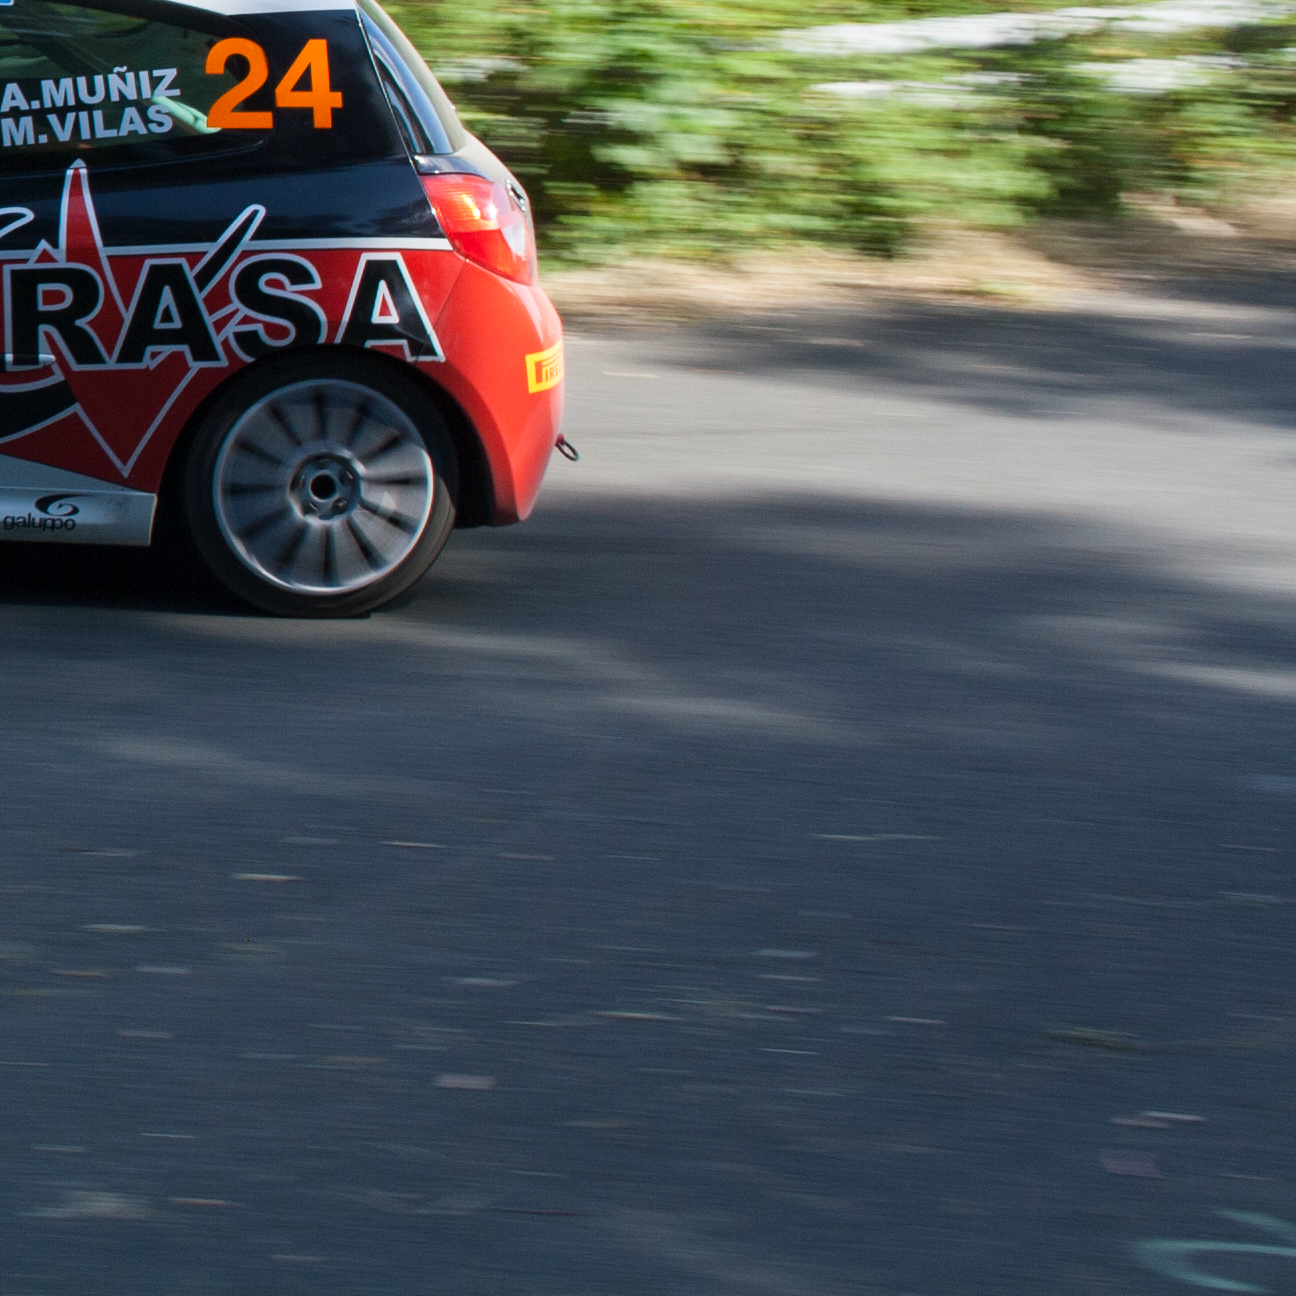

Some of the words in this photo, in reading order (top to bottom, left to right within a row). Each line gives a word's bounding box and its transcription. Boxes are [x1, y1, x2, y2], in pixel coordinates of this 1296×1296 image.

[0, 66, 180, 113] A.MUÑIZ
[205, 37, 343, 129] 24
[1, 104, 173, 147] M.VILAS
[2, 513, 76, 533] galuppo
